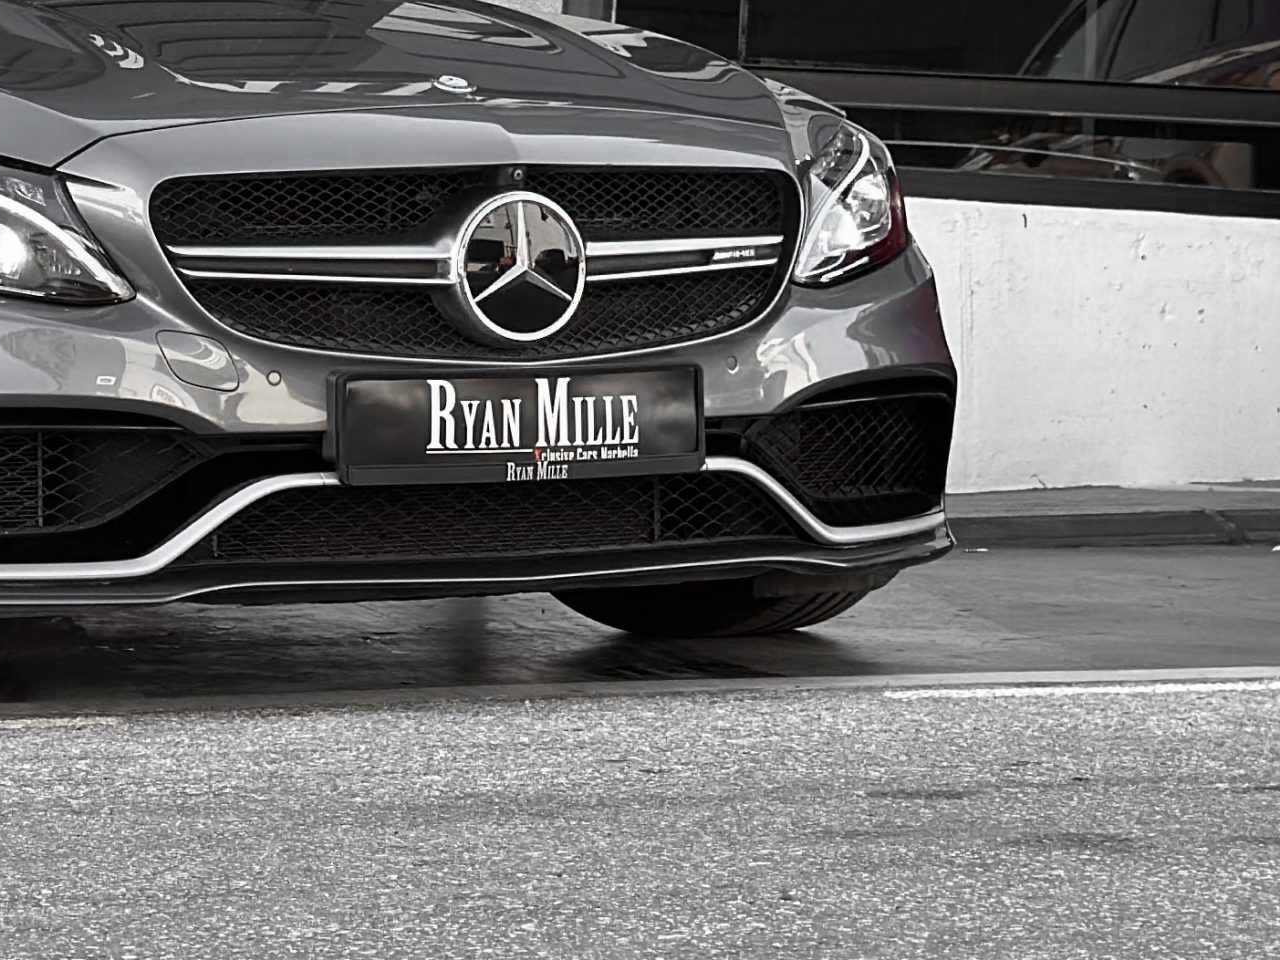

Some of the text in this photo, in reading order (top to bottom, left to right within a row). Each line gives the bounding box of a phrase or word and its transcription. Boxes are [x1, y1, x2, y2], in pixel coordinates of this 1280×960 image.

[426, 377, 639, 449] RYAN MILLE
[576, 448, 598, 460] Cars
[506, 460, 569, 482] RYAN MILLE
